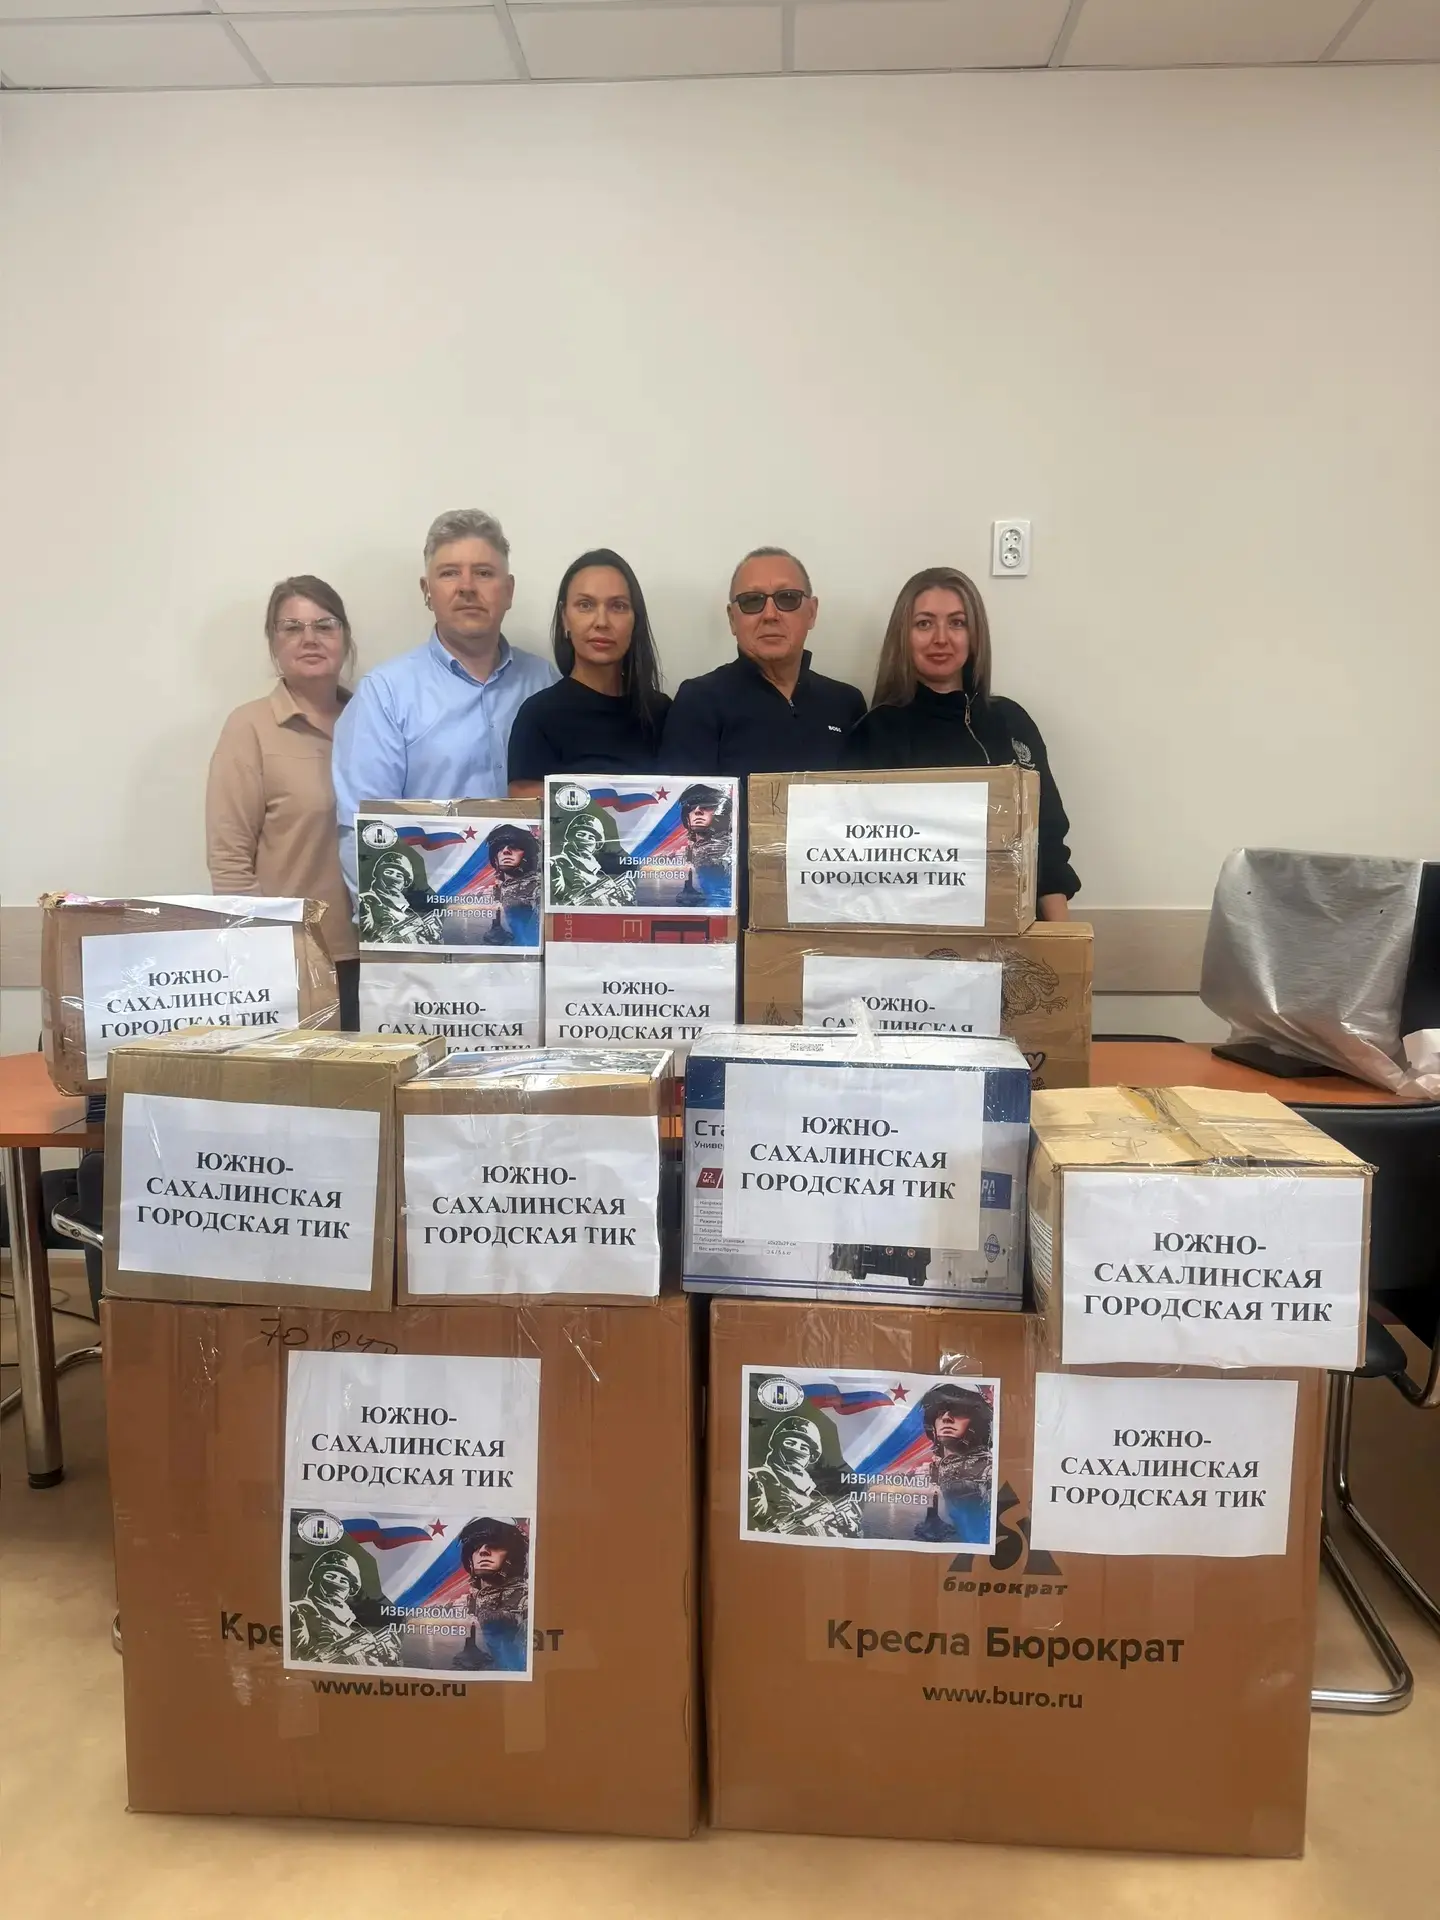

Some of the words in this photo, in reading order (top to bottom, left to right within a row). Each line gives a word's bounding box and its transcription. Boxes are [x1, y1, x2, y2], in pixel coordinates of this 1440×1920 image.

[845, 823, 920, 840] ЮЖНО-
[618, 856, 685, 867] ИЗБИРКОМЫ
[806, 847, 959, 863] САХАЛИНСКАЯ
[624, 869, 646, 880] ДЛЯ
[649, 870, 686, 881] ГЕРОЕВ
[800, 870, 917, 887] ГОРОДСКАЯ
[923, 871, 966, 887] ТИК
[426, 894, 493, 905] ИЗБИРКОМЫ
[432, 908, 453, 918] ДЛЯ
[456, 909, 493, 919] ГЕРОЕВ
[148, 968, 229, 987] ЮЖНО-
[601, 980, 675, 996] ЮЖНО-
[106, 987, 271, 1015] САХАЛИНСКАЯ
[413, 1001, 487, 1016] ЮЖНО-
[564, 1002, 711, 1018] САХАЛИНСКАЯ
[236, 1010, 280, 1027] ТИК
[558, 1024, 673, 1042] ГОРОДСКАЯ
[801, 1115, 901, 1138] ЮЖНО-
[195, 1151, 295, 1177] ЮЖНО-
[749, 1142, 949, 1173] САХАЛИНСКАЯ
[481, 1165, 577, 1186] ЮЖНО-
[145, 1174, 342, 1210] САХАЛИНСКАЯ
[740, 1172, 896, 1198] ГОРОДСКАЯ
[901, 1177, 957, 1201] ТИК
[432, 1196, 626, 1216] САХАЛИНСКАЯ
[135, 1204, 290, 1238] ГОРОДСКАЯ
[298, 1217, 351, 1241] ТИК
[424, 1225, 576, 1247] ГОРОДСКАЯ
[584, 1226, 638, 1247] ТИК
[1153, 1231, 1267, 1256] ЮЖНО-
[1093, 1261, 1322, 1290] САХАЛИНСКАЯ
[1083, 1294, 1262, 1322] ГОРОДСКАЯ
[1270, 1300, 1334, 1323] ТИК
[360, 1404, 459, 1427] ЮЖНО-
[310, 1432, 506, 1459] САХАЛИНСКАЯ
[1113, 1428, 1213, 1449] ЮЖНО-
[301, 1462, 455, 1488] ГОРОДСКАЯ
[460, 1468, 515, 1489] ТИК
[1059, 1455, 1260, 1480] САХАЛИНСКАЯ
[840, 1472, 929, 1488] ИЗБИРКОМЫ
[847, 1491, 876, 1504] ДЛЯ
[880, 1492, 929, 1506] ГЕРОЕВ
[1049, 1484, 1208, 1511] ГОРОДСКАЯ
[1214, 1488, 1268, 1509] ТИК
[942, 1576, 1069, 1600] бюрократ
[380, 1605, 467, 1619] ИЗБИРКОМЫ
[387, 1622, 415, 1635] ДЛЯ
[419, 1624, 467, 1637] ГЕРОЕВ
[827, 1618, 970, 1658] Кресла
[986, 1626, 1185, 1670] Бюрократ
[310, 1678, 467, 1697] www.buro.ru
[922, 1685, 1084, 1709] www.buro.ru
